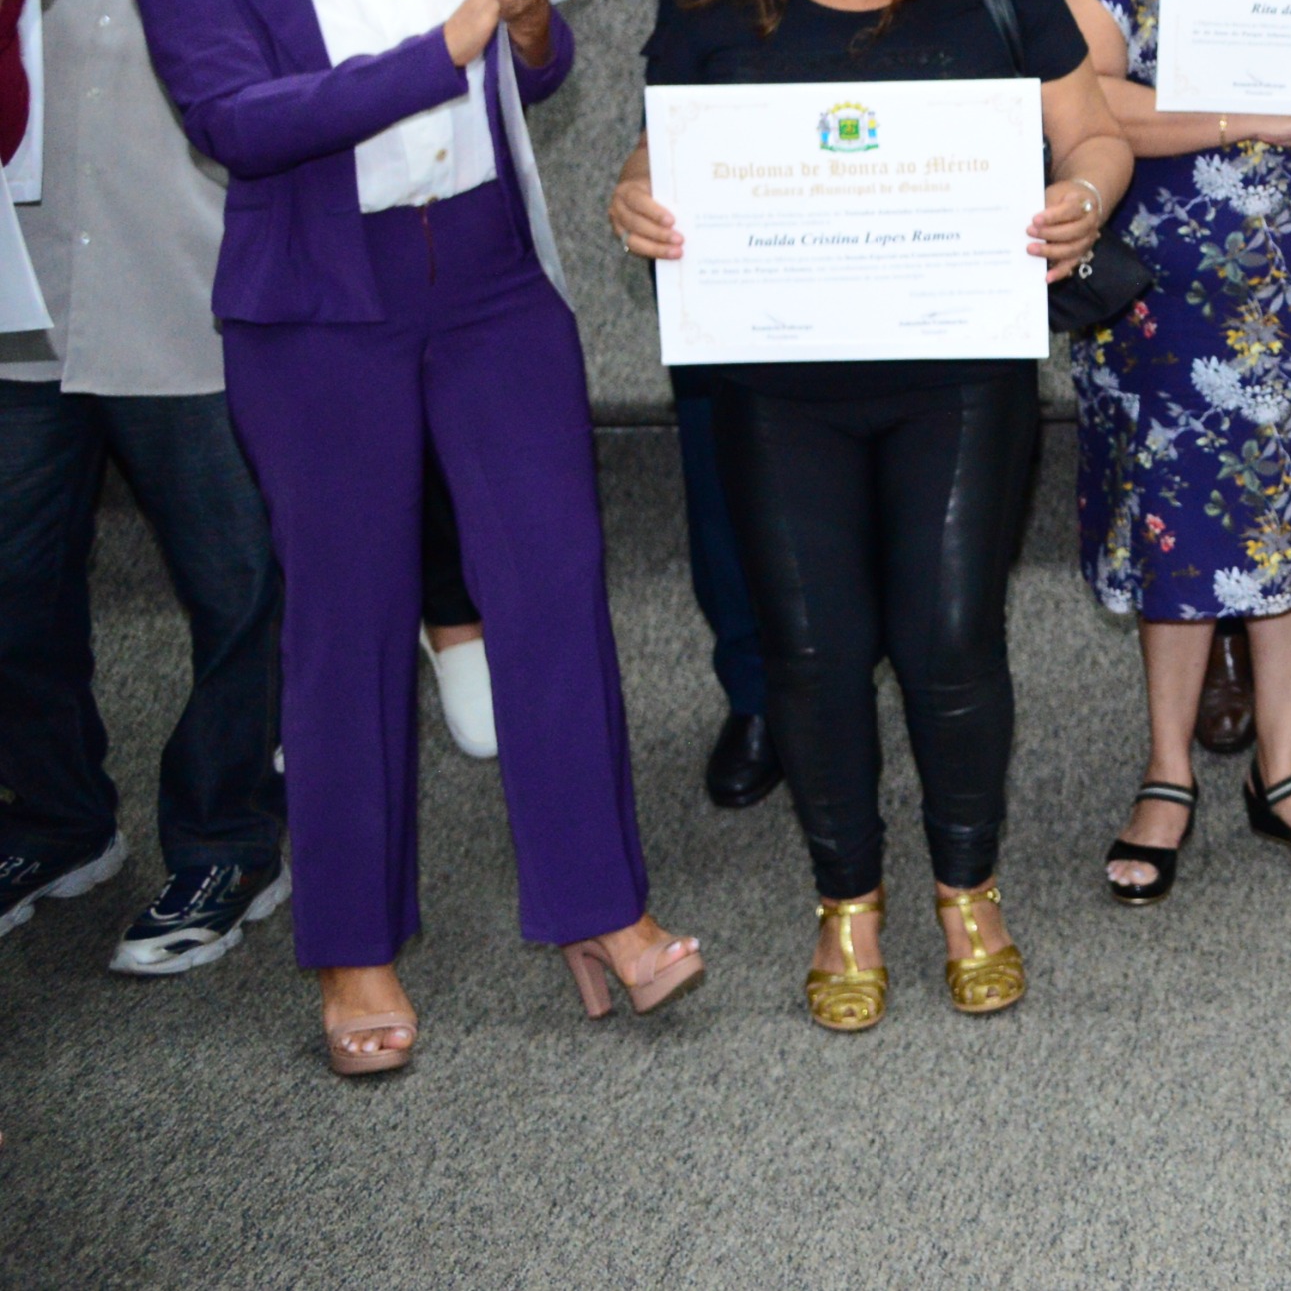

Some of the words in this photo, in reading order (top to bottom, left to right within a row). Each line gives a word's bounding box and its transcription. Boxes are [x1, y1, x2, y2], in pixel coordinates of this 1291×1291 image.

[1251, 3, 1278, 15] Rita
[712, 162, 794, 180] Diploma
[800, 162, 820, 177] de
[829, 160, 889, 177] Honra
[896, 160, 917, 173] ao
[924, 155, 990, 175] Mérito
[748, 234, 796, 247] Inalda
[801, 232, 859, 246] Cristina
[865, 230, 907, 247] Lopes
[912, 228, 960, 242] Ramos
